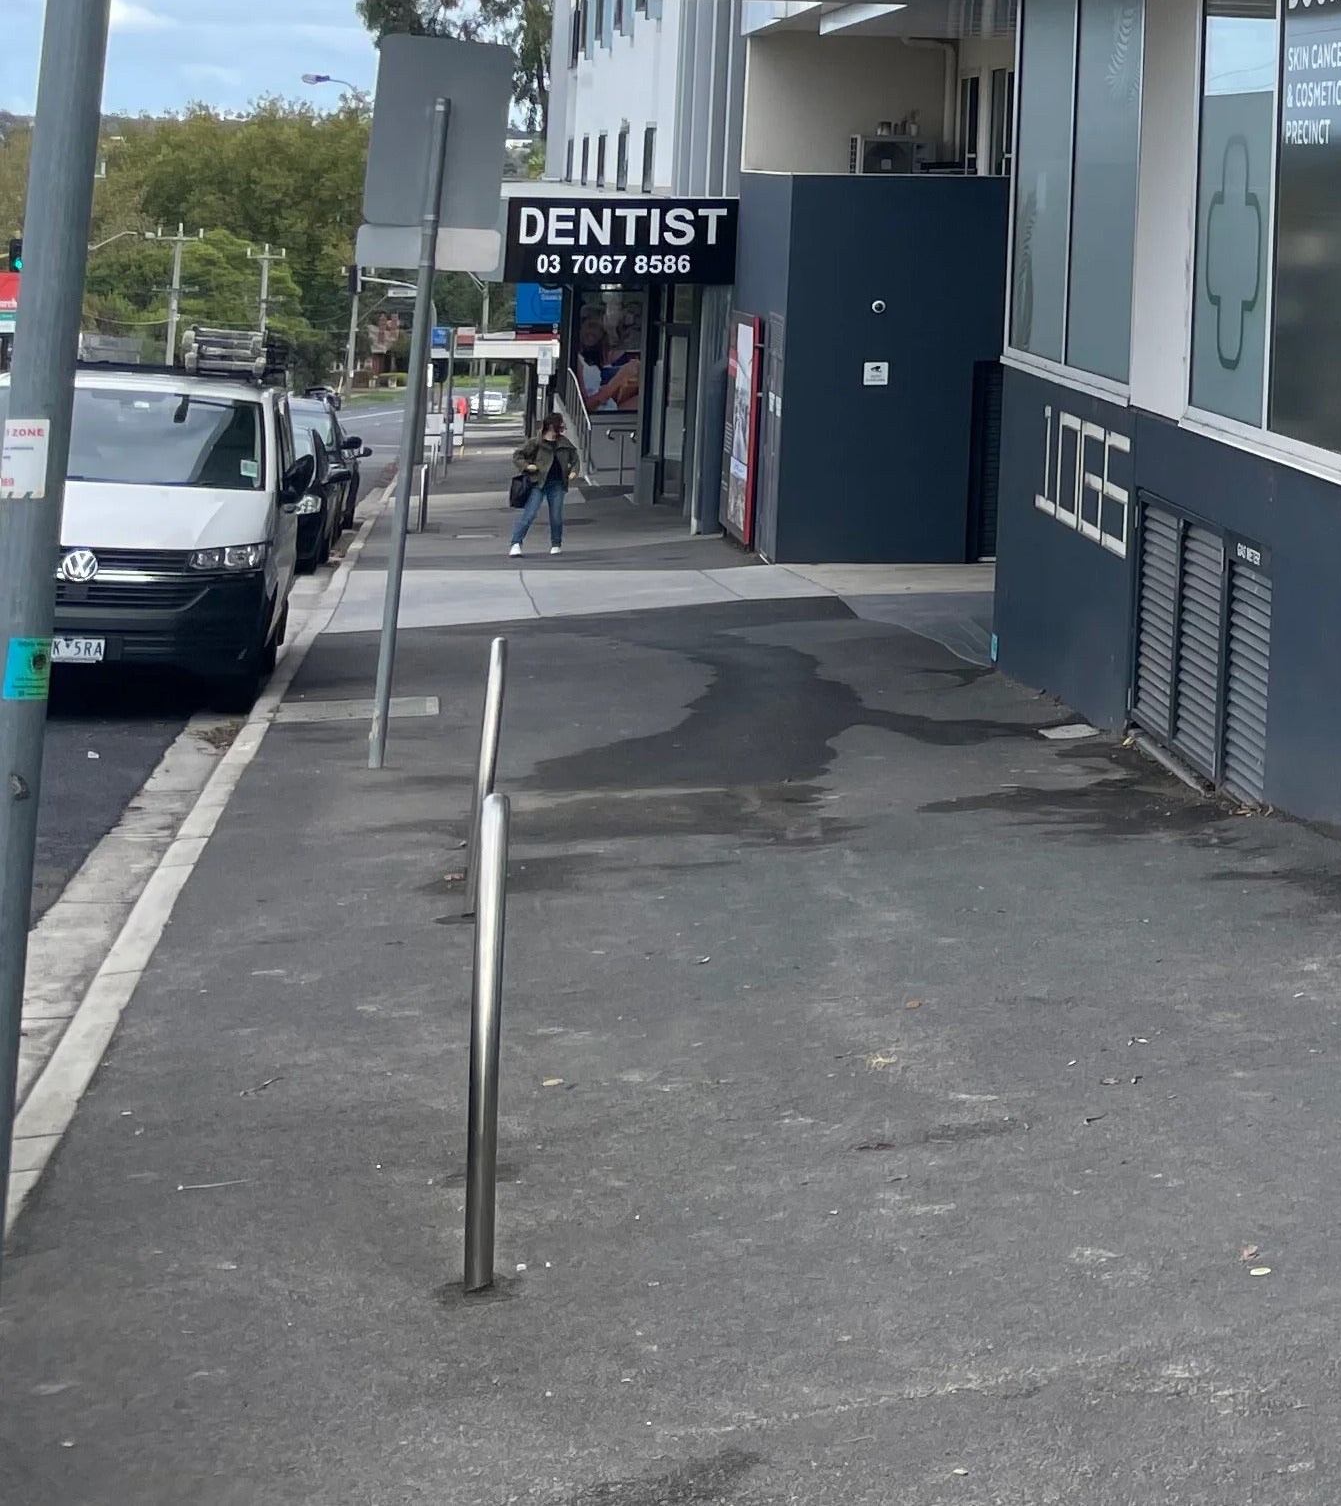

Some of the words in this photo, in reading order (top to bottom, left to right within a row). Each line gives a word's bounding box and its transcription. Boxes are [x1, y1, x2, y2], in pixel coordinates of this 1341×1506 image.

[1288, 45, 1309, 72] SKIN
[1287, 83, 1294, 108] &
[1286, 119, 1330, 145] PRECINCT
[519, 207, 728, 245] DENTIST
[536, 254, 561, 274] 03
[572, 255, 626, 274] 7067
[634, 255, 690, 274] 8586
[12, 428, 45, 437] ZONE
[1034, 405, 1131, 559] 1065
